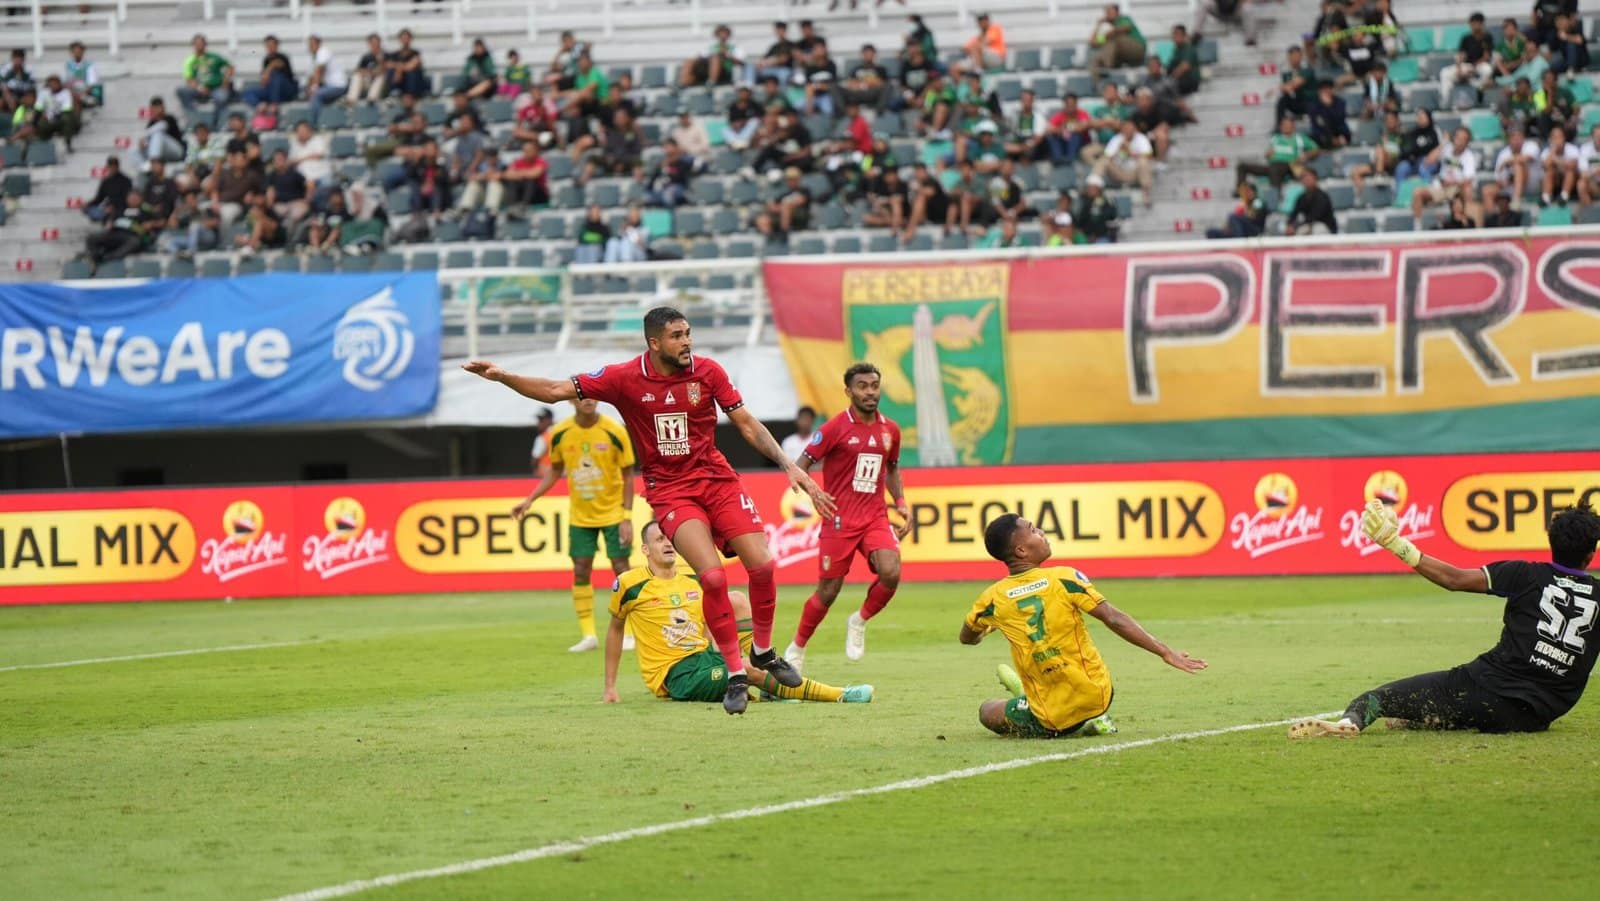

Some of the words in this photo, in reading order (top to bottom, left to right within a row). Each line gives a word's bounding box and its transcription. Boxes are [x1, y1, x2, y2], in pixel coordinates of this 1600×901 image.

[1, 322, 291, 390] RWeAre
[739, 493, 759, 515] 4
[1117, 496, 1208, 540] MIX
[94, 523, 180, 566] MIX
[418, 512, 562, 555] SPECI
[1016, 595, 1047, 642] 3
[1537, 584, 1600, 655] 52
